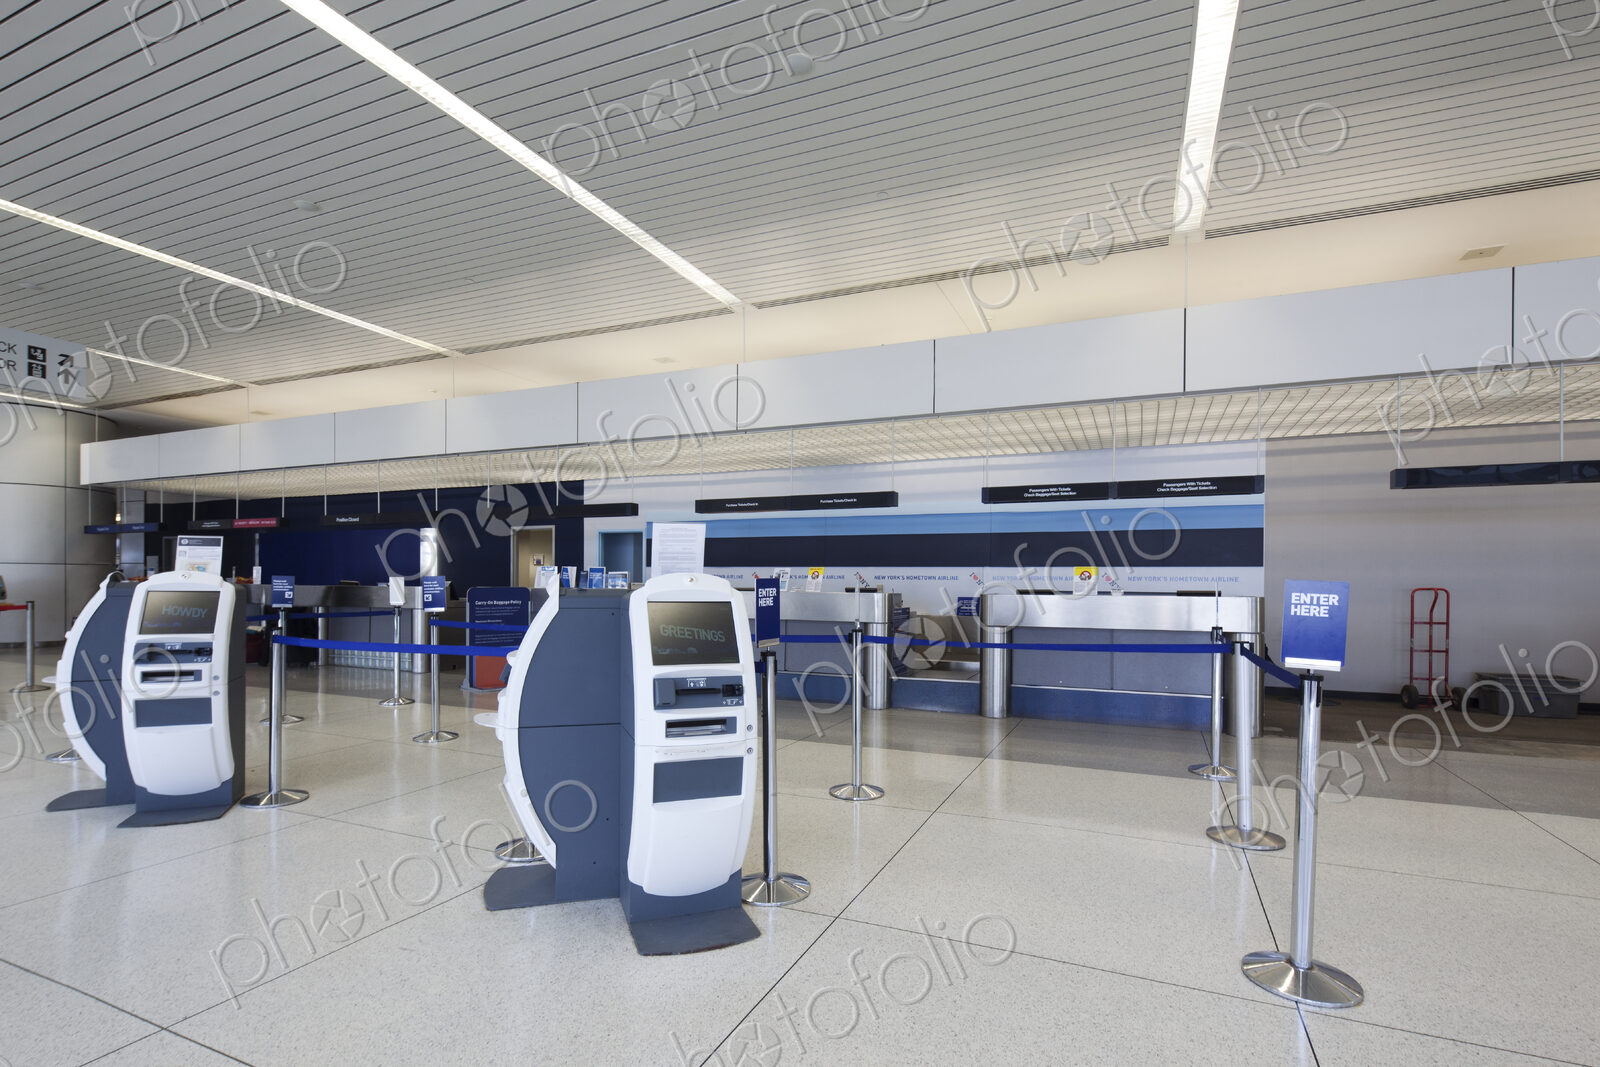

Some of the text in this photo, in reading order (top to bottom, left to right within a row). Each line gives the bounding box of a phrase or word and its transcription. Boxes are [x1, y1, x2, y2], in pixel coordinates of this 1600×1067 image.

[1169, 575, 1209, 583] HOMETOWN
[758, 588, 777, 597] ENTER
[1291, 592, 1339, 606] ENTER
[758, 597, 774, 607] HERE
[161, 604, 208, 618] HOWDY
[1290, 604, 1330, 617] HERE
[660, 624, 726, 642] GREETINGS
